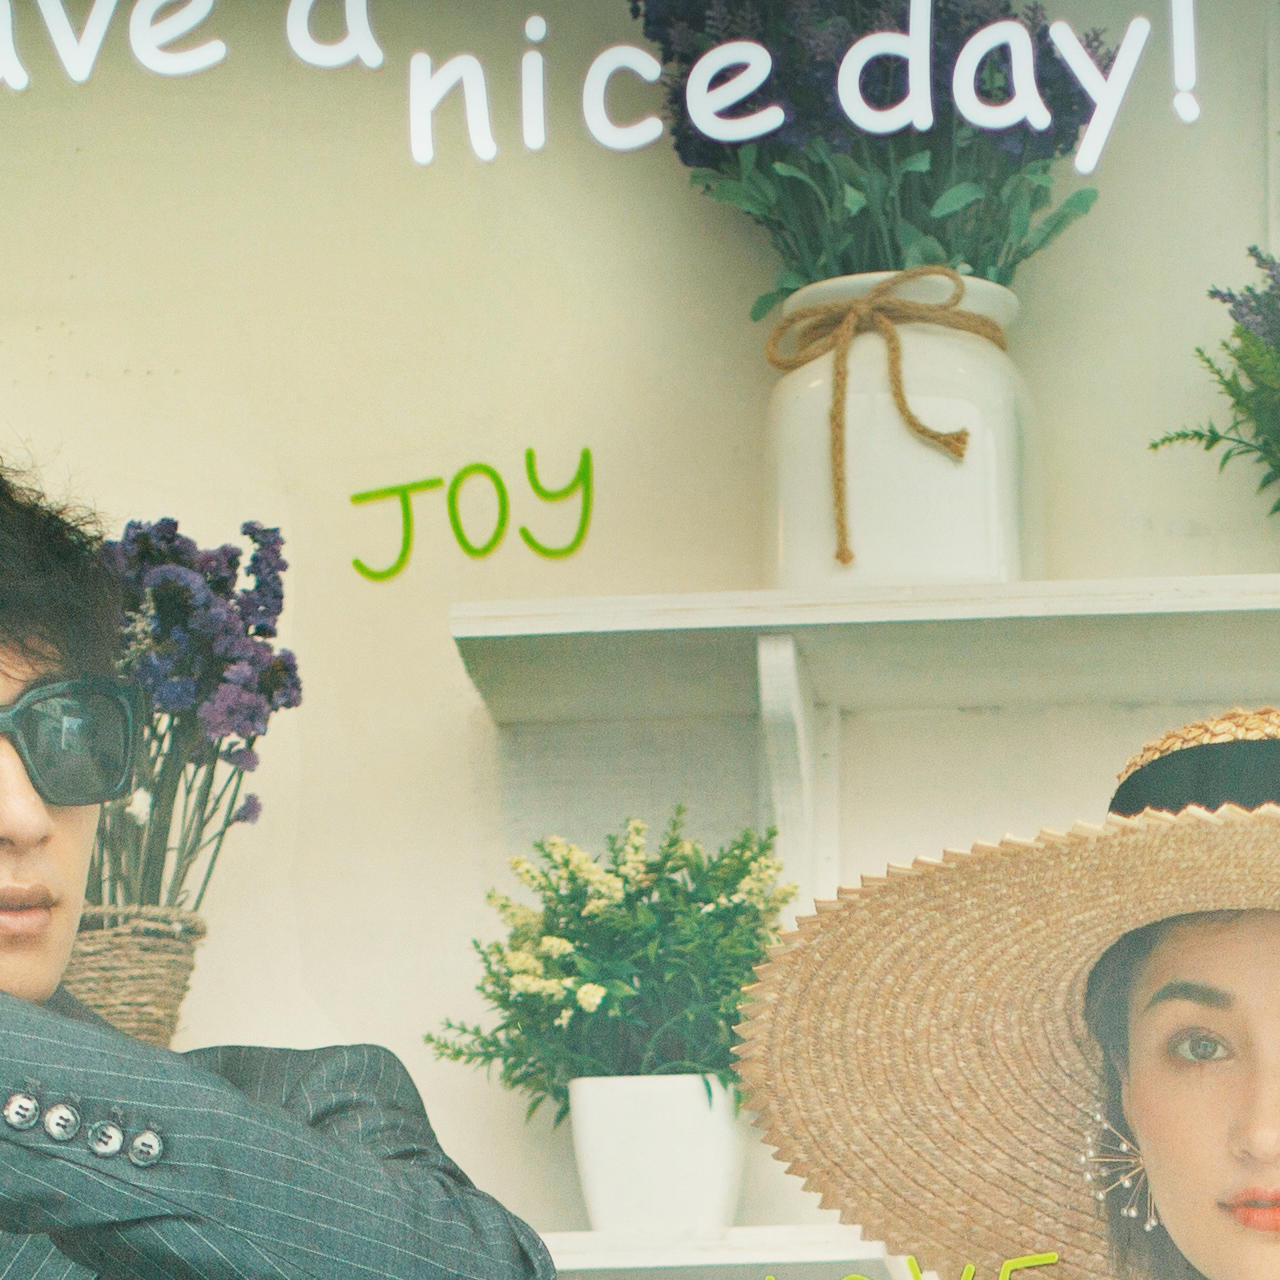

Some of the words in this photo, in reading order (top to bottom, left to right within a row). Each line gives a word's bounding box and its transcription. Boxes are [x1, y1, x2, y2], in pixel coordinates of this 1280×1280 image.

[286, 0, 384, 68] a
[408, 16, 786, 166] nice
[837, 0, 1201, 176] day!
[347, 446, 596, 583] JOY
